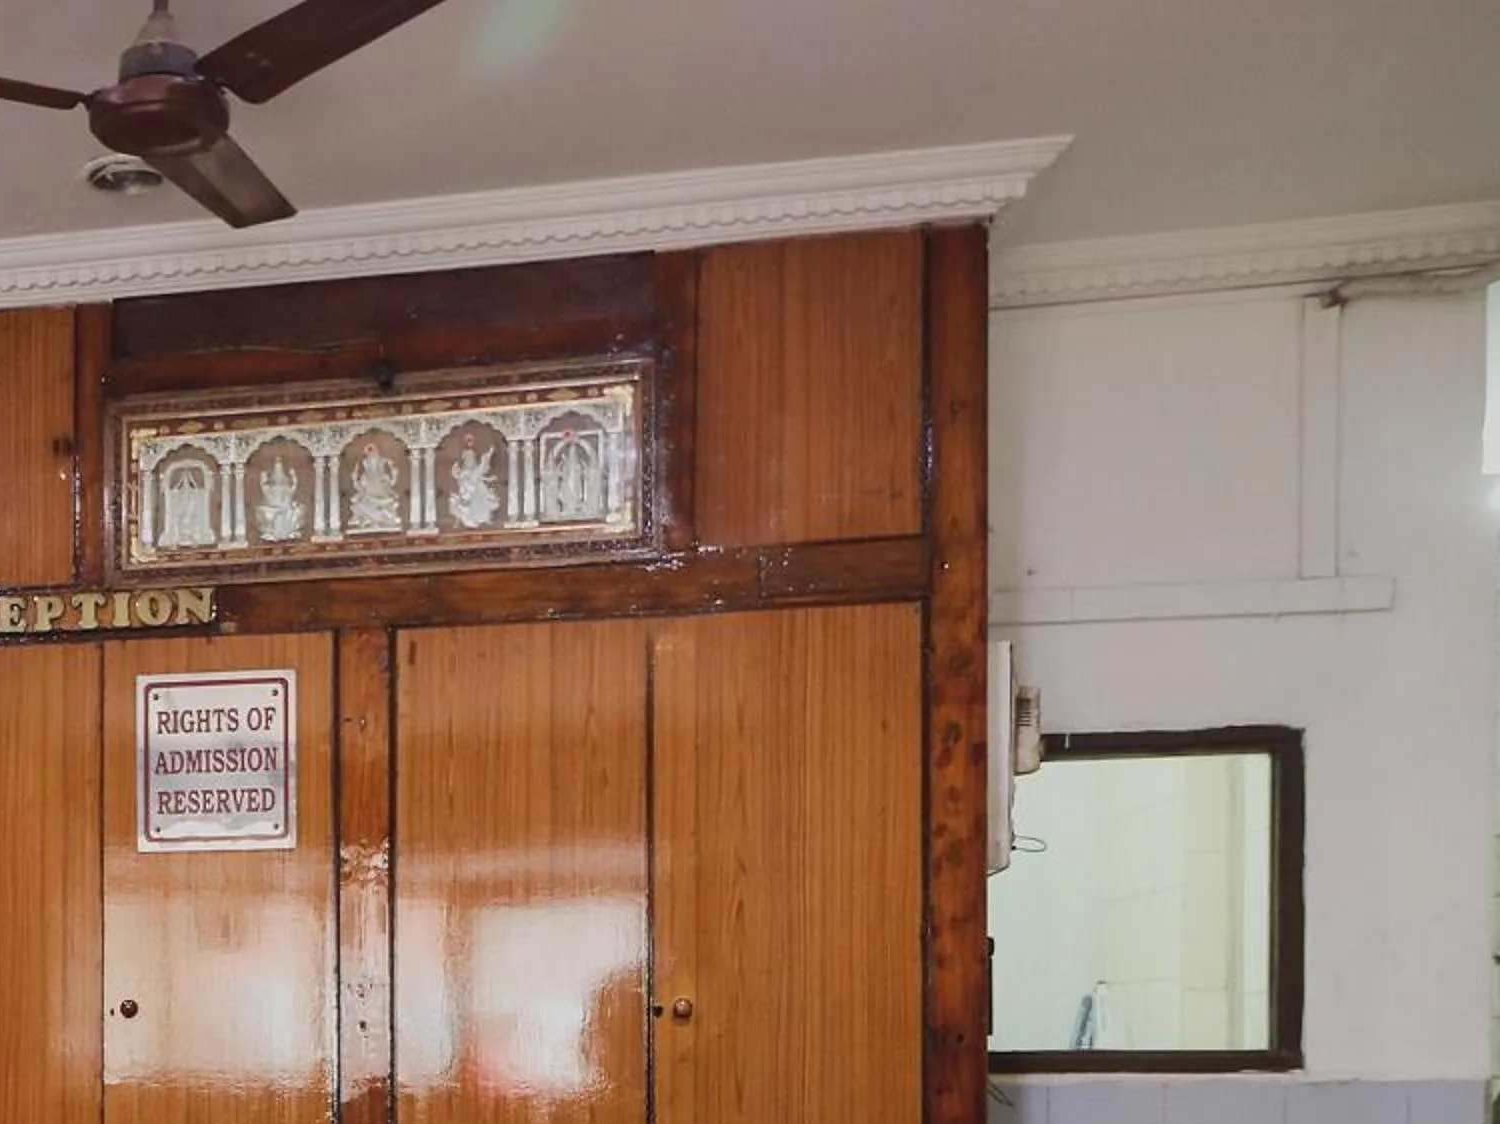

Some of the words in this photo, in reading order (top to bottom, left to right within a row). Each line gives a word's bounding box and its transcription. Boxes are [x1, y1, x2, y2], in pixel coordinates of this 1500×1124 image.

[156, 708, 240, 735] RIGHTS
[246, 707, 277, 731] OF
[155, 746, 278, 774] ADMISSION
[156, 787, 276, 815] RESERVED
